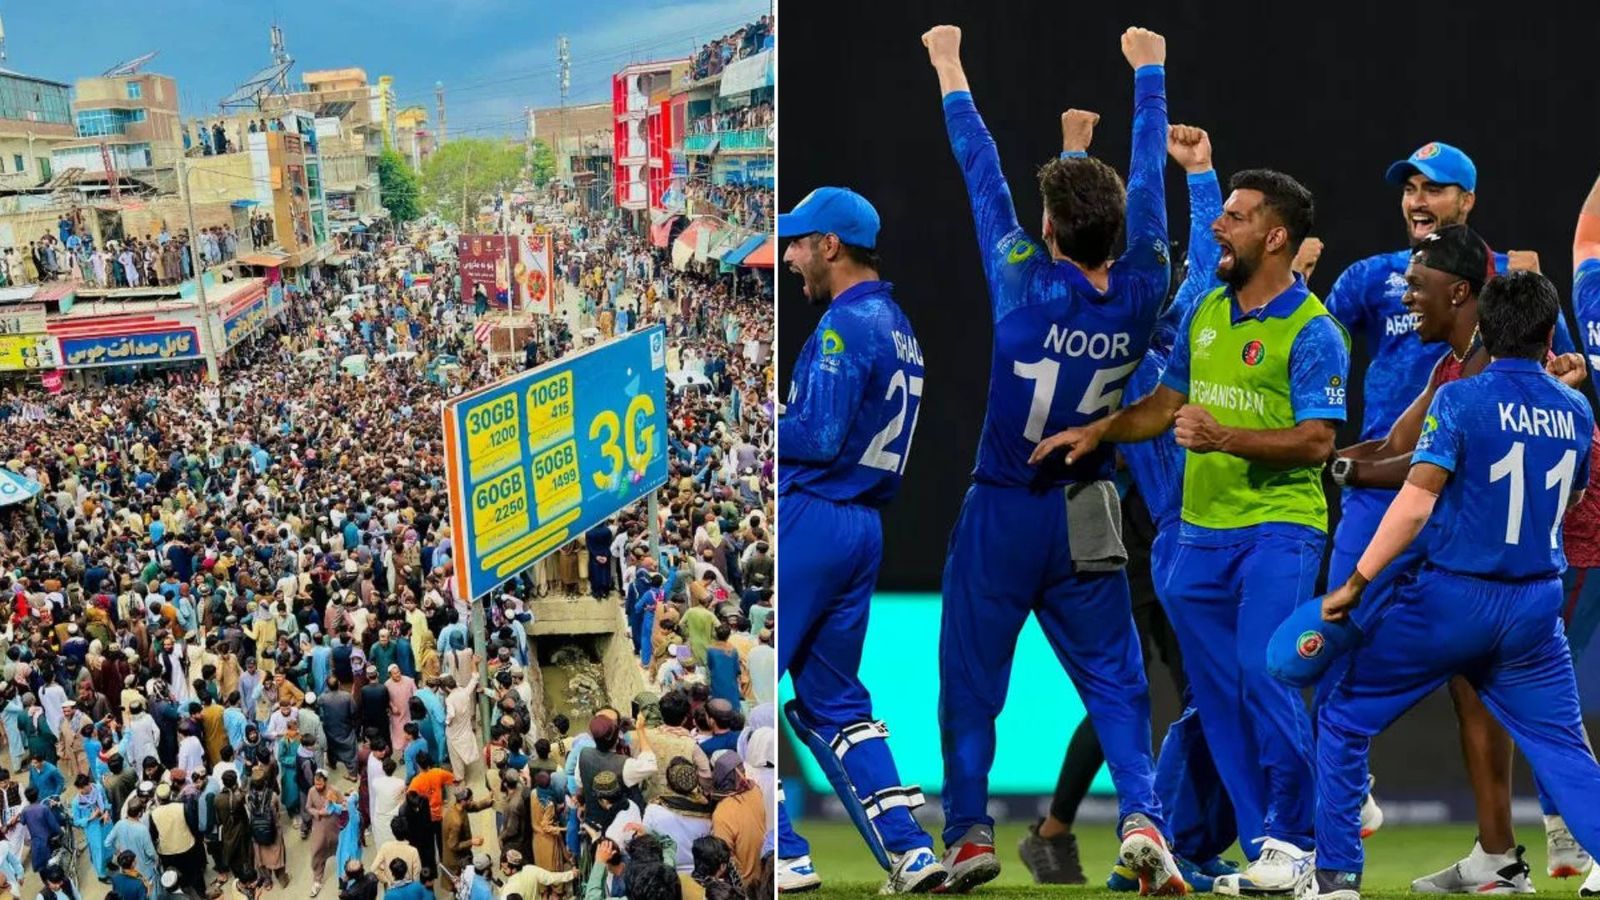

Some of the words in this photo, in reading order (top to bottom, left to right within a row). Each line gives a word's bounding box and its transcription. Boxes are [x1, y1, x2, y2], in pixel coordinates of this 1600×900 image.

[160, 335, 191, 357] کابل
[1043, 323, 1130, 360] NOOR
[530, 377, 568, 408] 10GB
[551, 400, 569, 418] 415
[1013, 357, 1140, 444] 15
[1324, 387, 1345, 397] TLC
[1328, 397, 1343, 405] 2.0
[469, 399, 515, 435] 30GB
[858, 369, 924, 476] 27
[1498, 402, 1577, 441] KARIM
[489, 424, 516, 448] 1200
[589, 394, 656, 491] 3G
[535, 445, 574, 480] 50GB
[552, 468, 576, 491] 1499
[477, 473, 522, 510] 60GB
[1489, 441, 1577, 549] 11
[495, 497, 524, 522] 2250
